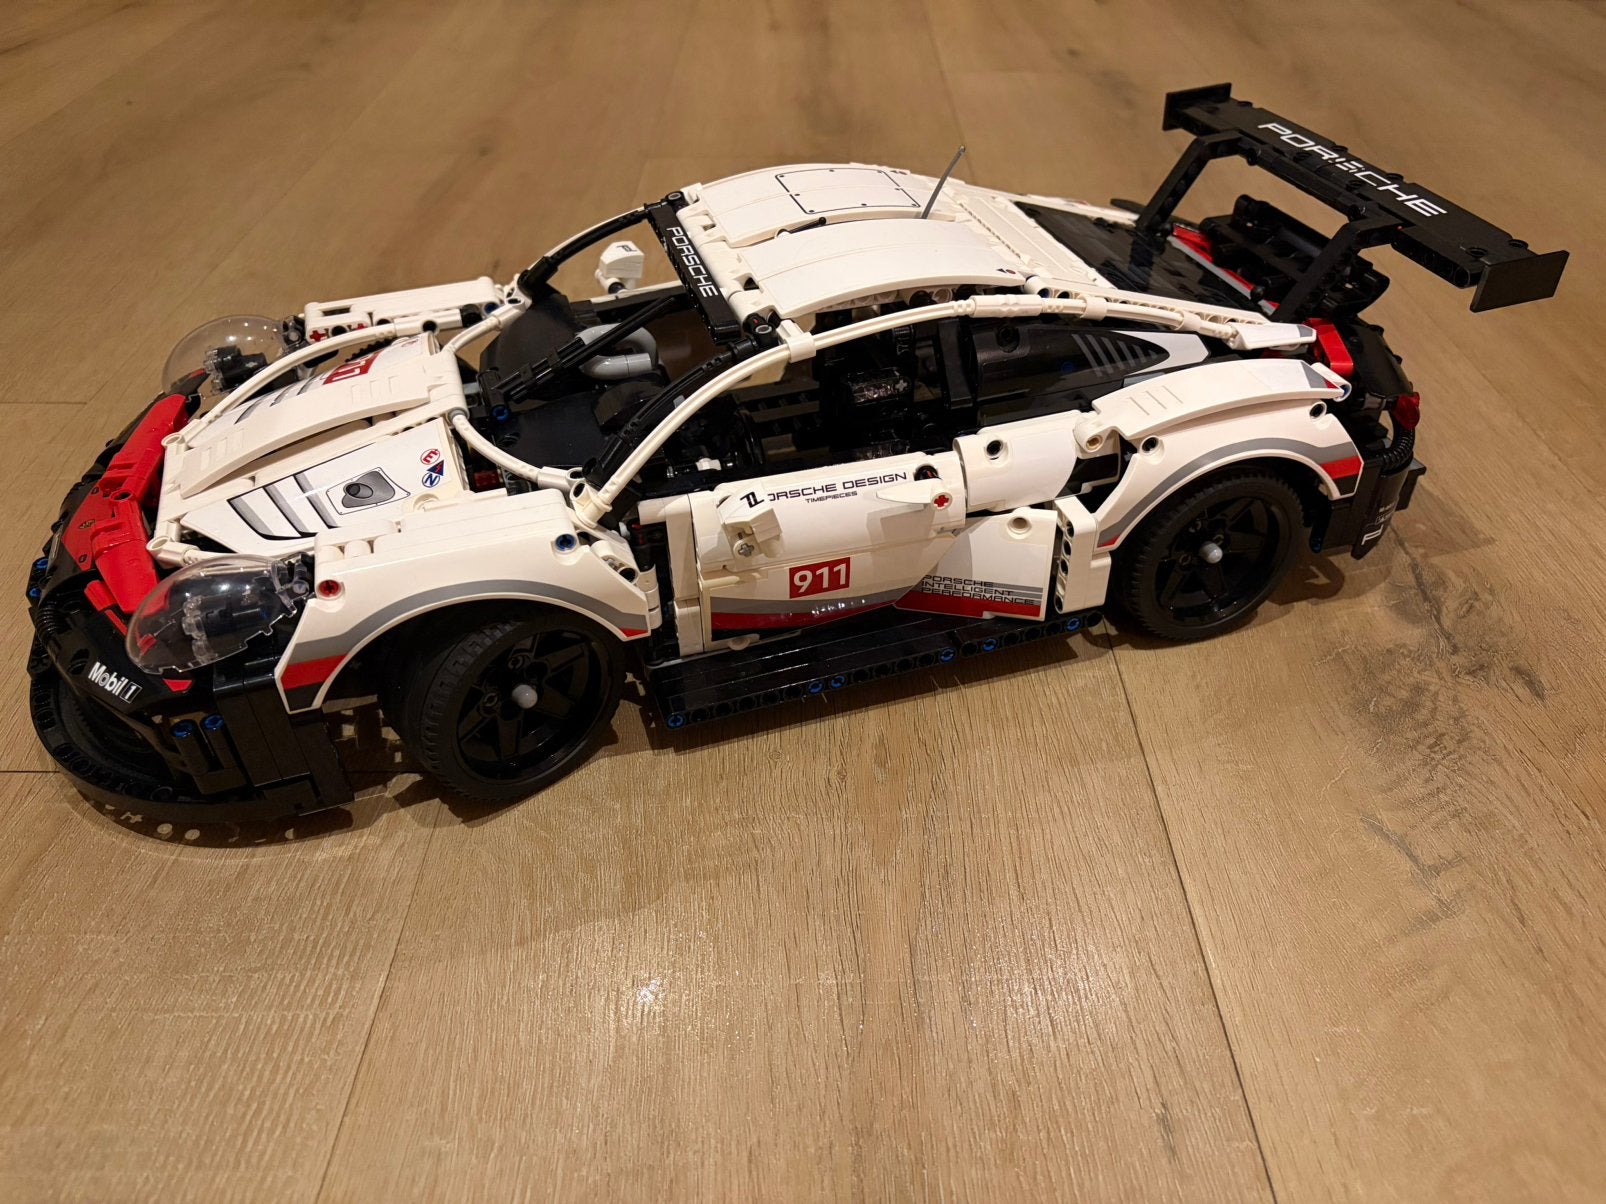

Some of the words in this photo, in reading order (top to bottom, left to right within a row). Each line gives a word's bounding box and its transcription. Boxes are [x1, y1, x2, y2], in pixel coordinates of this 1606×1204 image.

[1258, 122, 1448, 217] PORSCHE
[666, 226, 719, 298] PORSCHE
[767, 483, 838, 502] ORSCHE
[842, 472, 908, 490] DESIGN
[805, 490, 858, 504] TIMEPIECES
[793, 563, 847, 593] 911
[920, 580, 1014, 596] INTELLIGENT
[922, 574, 994, 588] PORSCHE
[920, 587, 1035, 606] PERFORMANCE
[87, 661, 129, 696] Mobil
